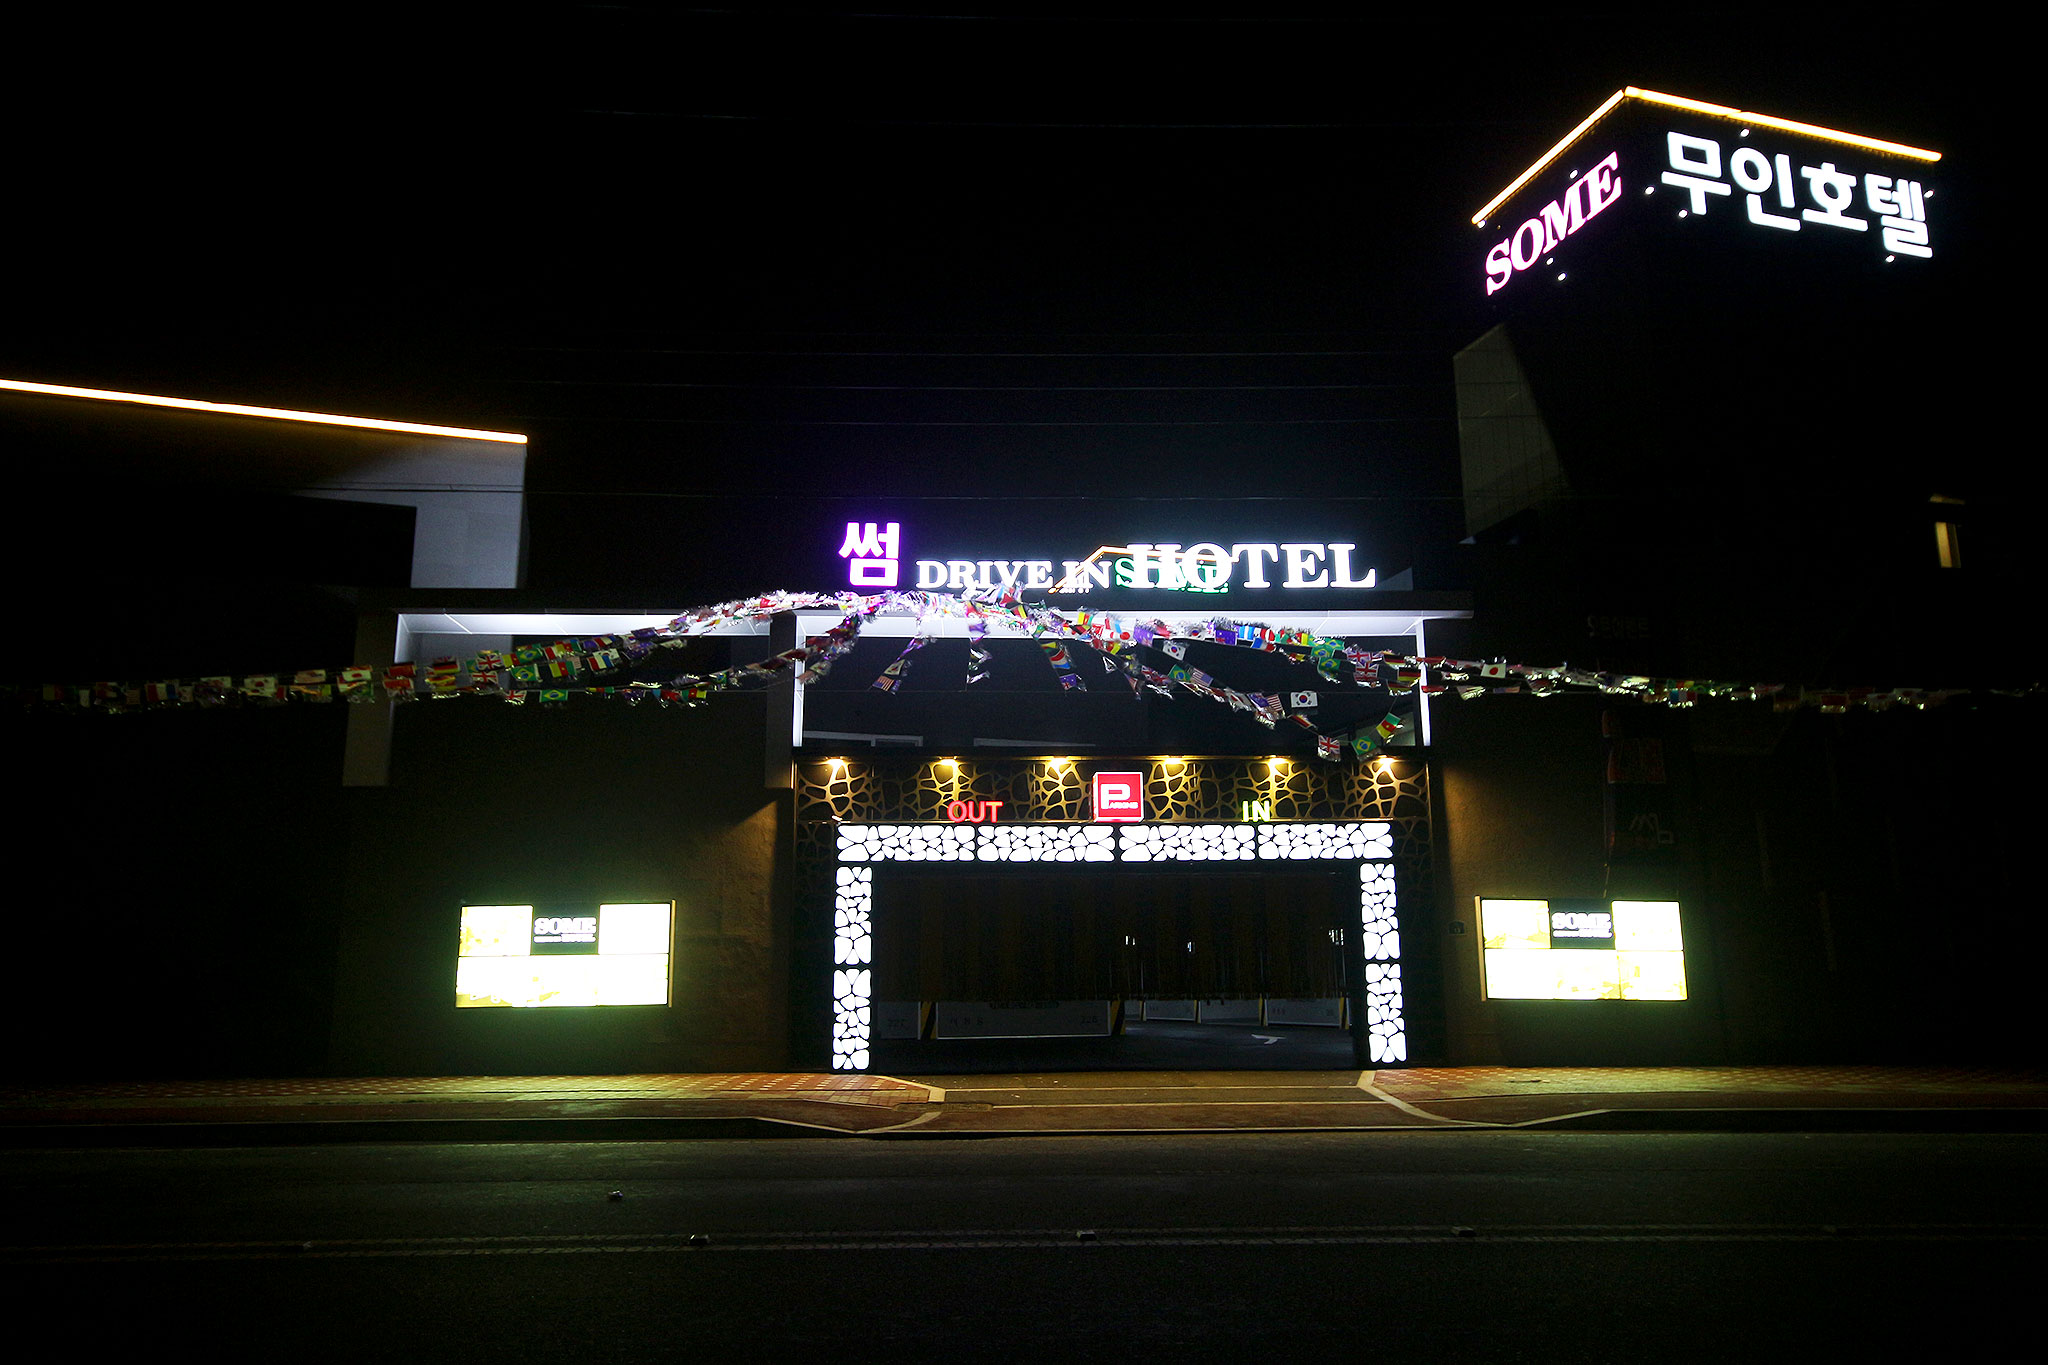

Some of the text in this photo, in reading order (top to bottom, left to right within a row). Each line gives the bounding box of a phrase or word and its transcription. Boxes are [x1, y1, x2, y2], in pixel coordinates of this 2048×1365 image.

[1661, 131, 1933, 258] 무인호텔
[1485, 151, 1622, 296] SOME
[839, 521, 899, 588] 썸
[916, 560, 1053, 590] DRIVE
[1061, 560, 1110, 590] IN
[1126, 542, 1377, 589] HOTEL
[947, 800, 1003, 823] OUT
[1242, 800, 1272, 823] IN
[533, 917, 597, 935] SOME
[1551, 912, 1612, 930] SOME
